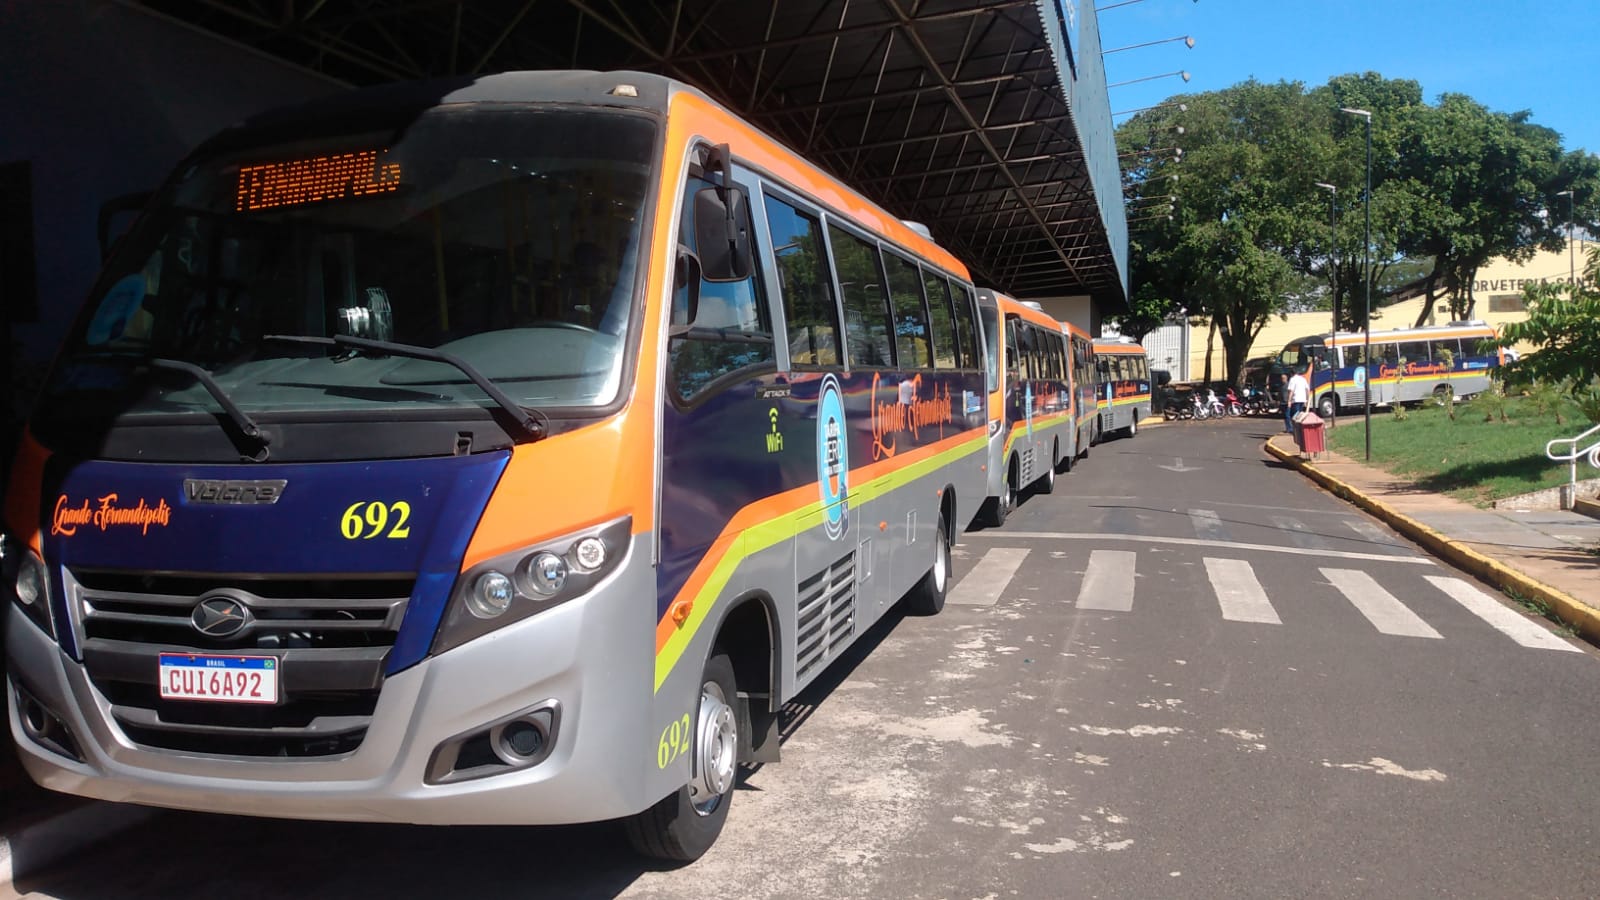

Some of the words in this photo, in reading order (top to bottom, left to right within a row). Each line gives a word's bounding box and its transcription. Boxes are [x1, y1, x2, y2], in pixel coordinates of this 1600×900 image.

[1471, 278, 1547, 292] ORVETEA
[870, 371, 906, 461] Grande
[51, 494, 92, 536] Grande
[93, 493, 171, 536] Fernandópolis
[340, 500, 411, 540] 692
[169, 669, 262, 697] CUI6A92
[206, 659, 226, 668] BRASIL
[657, 712, 690, 769] 692
